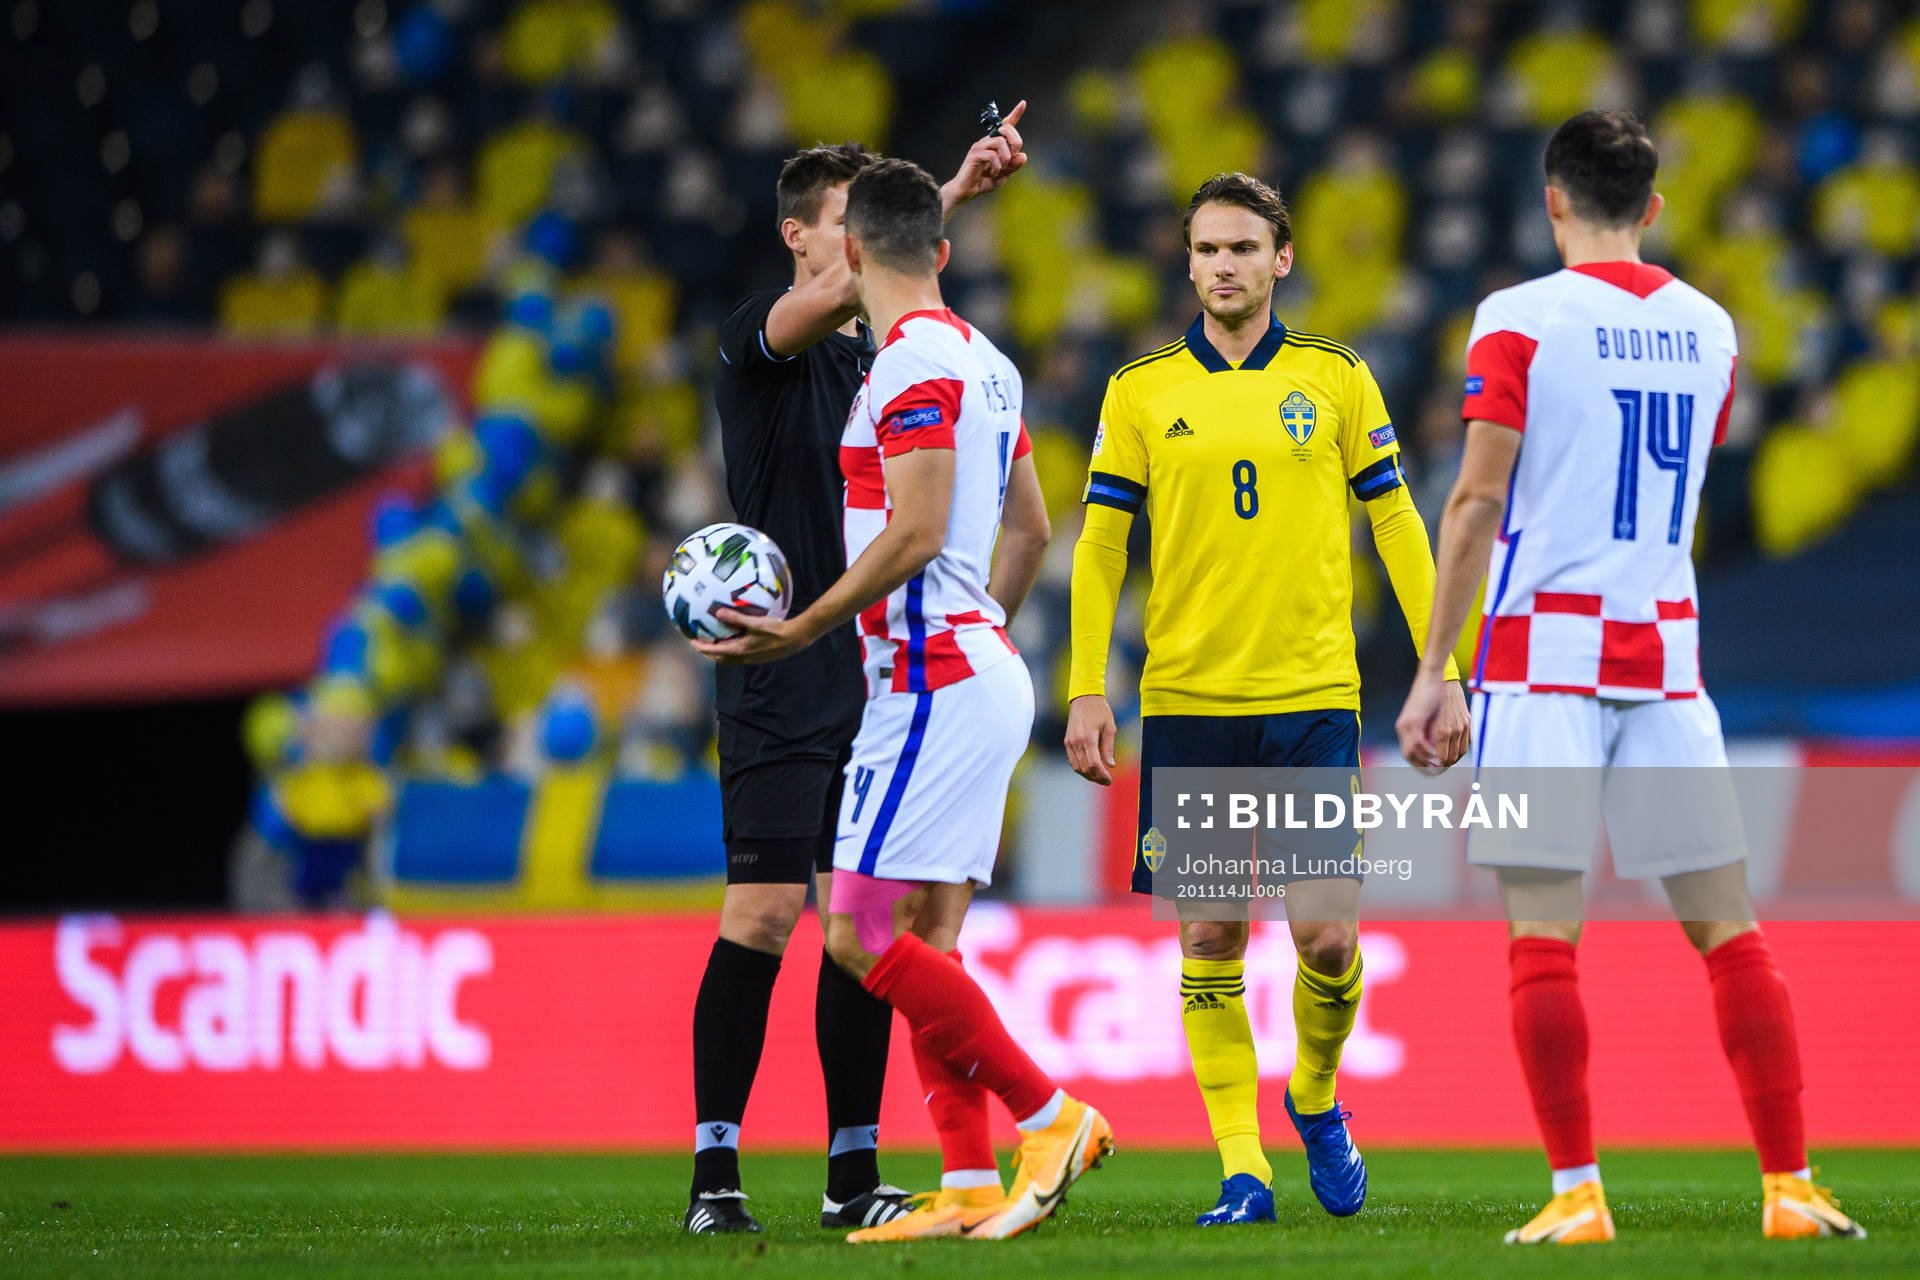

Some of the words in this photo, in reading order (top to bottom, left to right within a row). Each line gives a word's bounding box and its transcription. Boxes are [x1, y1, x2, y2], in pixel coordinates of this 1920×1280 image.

[1596, 327, 1700, 363] BUDIMIR
[1164, 429, 1195, 439] adidas
[1232, 459, 1259, 520] 8
[1610, 388, 1695, 545] 14
[852, 764, 875, 824] 4
[52, 908, 494, 1073] Scandic
